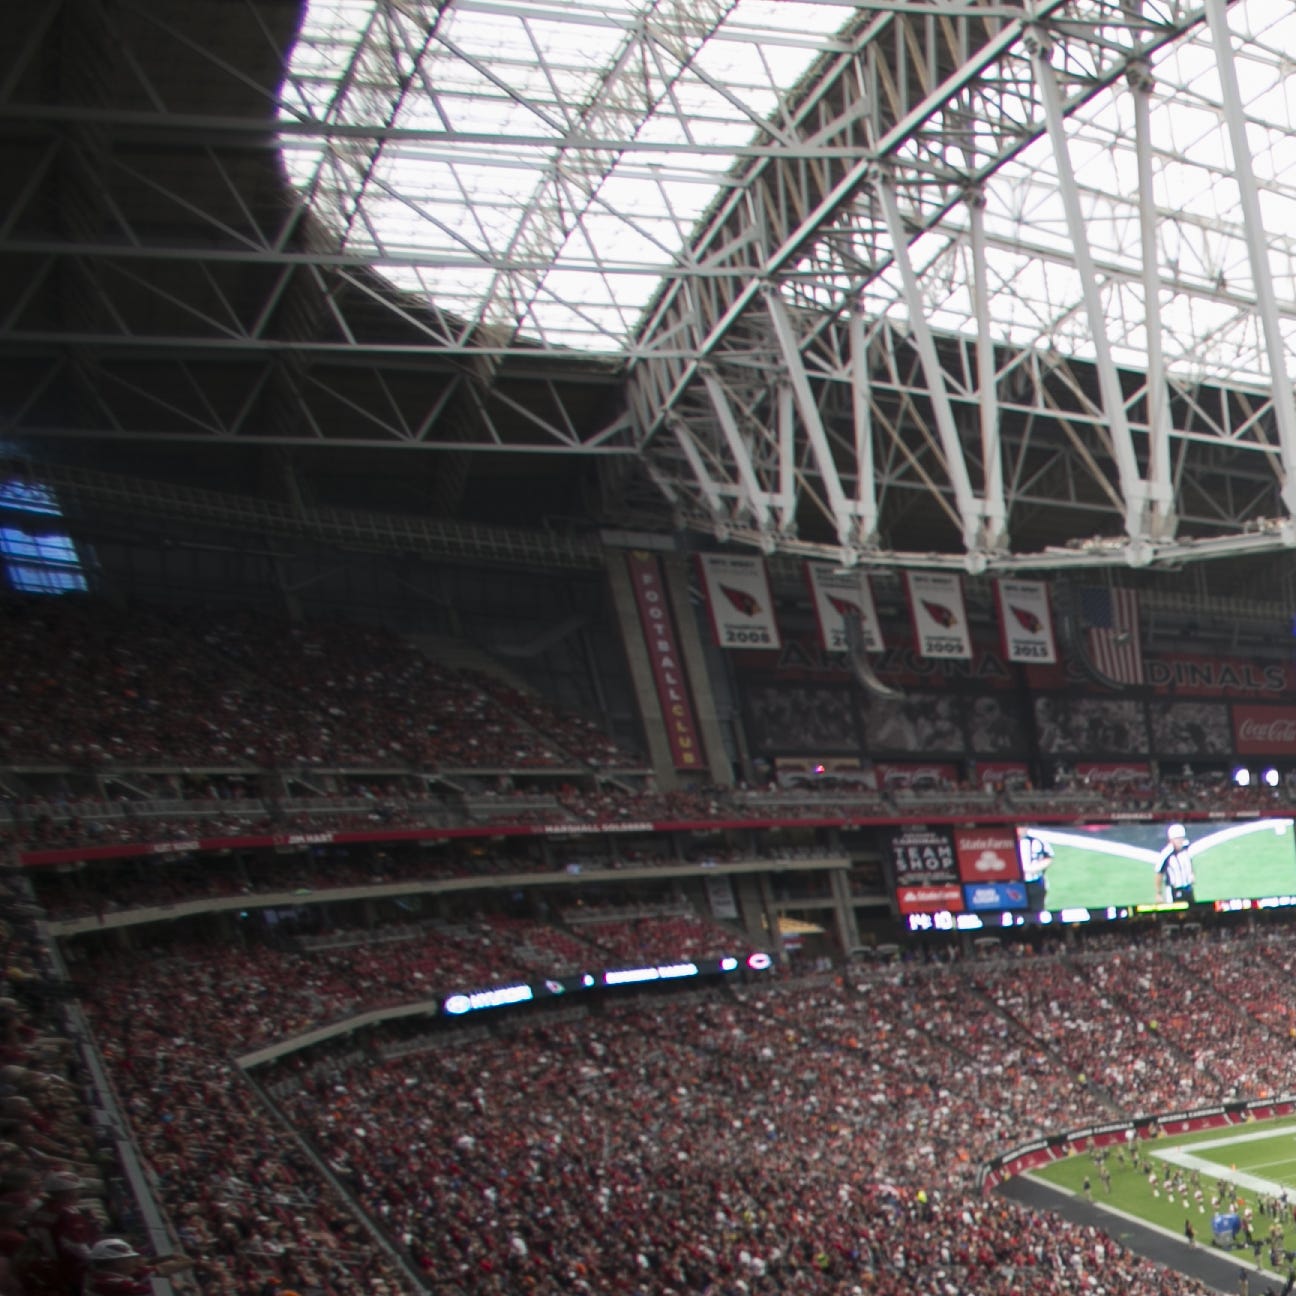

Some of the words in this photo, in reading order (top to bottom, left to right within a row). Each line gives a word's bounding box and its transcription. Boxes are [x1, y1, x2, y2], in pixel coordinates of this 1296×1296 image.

[643, 573, 682, 702] FOOTBALL
[725, 629, 772, 644] 2008
[925, 641, 965, 655] 2009
[1012, 643, 1049, 657] 2015
[672, 704, 696, 765] CLUB
[892, 844, 954, 859] TEAM
[896, 857, 955, 872] SHOP
